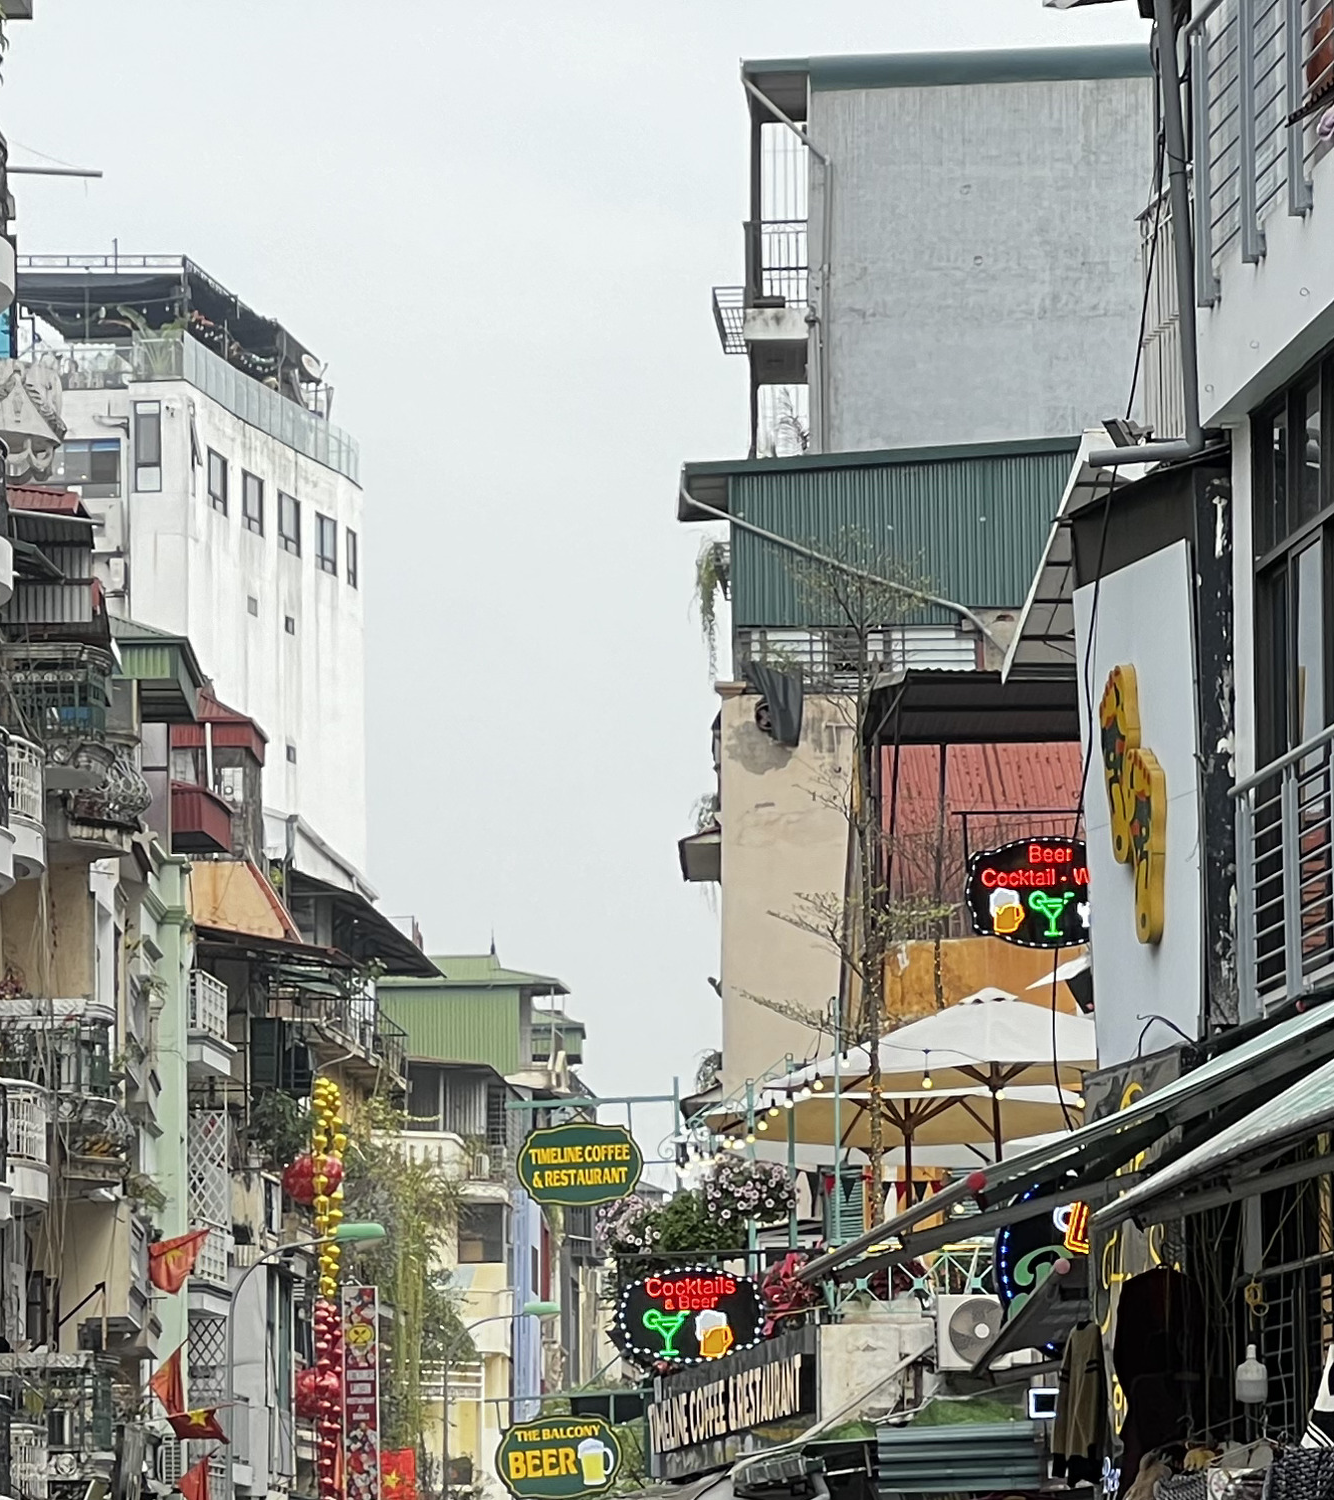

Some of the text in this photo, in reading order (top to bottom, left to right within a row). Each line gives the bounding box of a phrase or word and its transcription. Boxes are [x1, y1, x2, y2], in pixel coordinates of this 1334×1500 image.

[1028, 844, 1073, 864] Beer
[981, 867, 1056, 888] Cocktail
[529, 1144, 630, 1165] TIMELINE COFFEE
[532, 1167, 628, 1188] & RESTAURANT
[646, 1277, 737, 1298] Cocktails
[678, 1295, 718, 1310] Beer
[648, 1392, 690, 1453] TIMELINE
[689, 1379, 727, 1443] COFFEE
[515, 1424, 600, 1442] THE BALCONY
[508, 1447, 578, 1479] BEER
